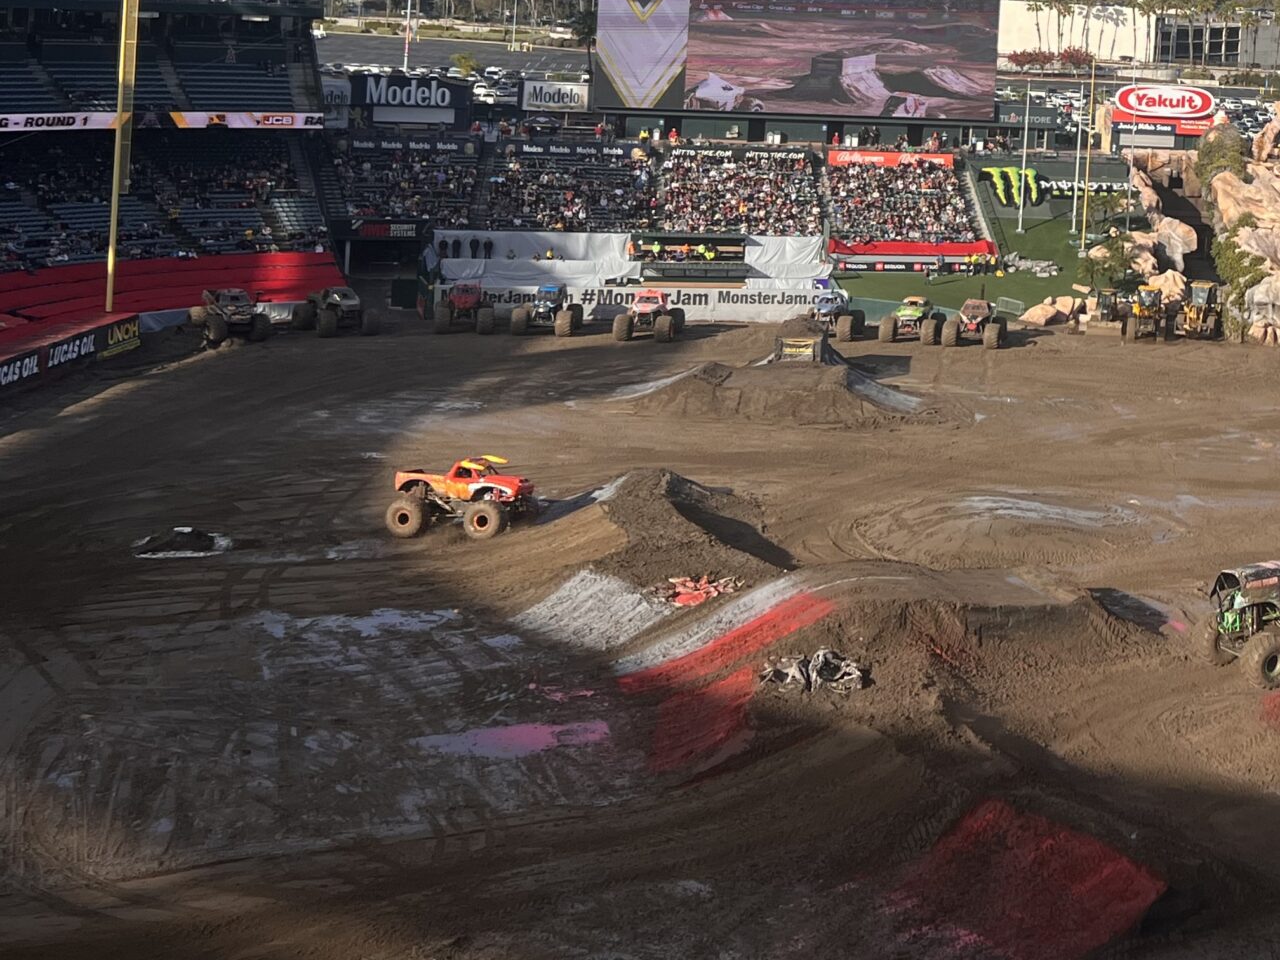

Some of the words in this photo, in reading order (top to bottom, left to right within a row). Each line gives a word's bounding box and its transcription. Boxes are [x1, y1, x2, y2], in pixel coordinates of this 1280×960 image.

[366, 76, 451, 106] Modelo
[531, 85, 580, 104] Modelo
[1136, 93, 1199, 110] Yakult
[24, 117, 76, 127] ROUND
[82, 116, 88, 126] 1
[265, 116, 294, 125] JCB
[1000, 113, 1022, 124] TEAM
[1024, 114, 1051, 124] STORE
[672, 148, 696, 157] NITTO
[745, 150, 769, 159] NITTO
[769, 151, 805, 160] TIRE.COM
[107, 320, 139, 345] UNOH
[48, 339, 80, 368] LUCAS
[80, 334, 95, 356] OIL
[22, 354, 40, 378] OIL
